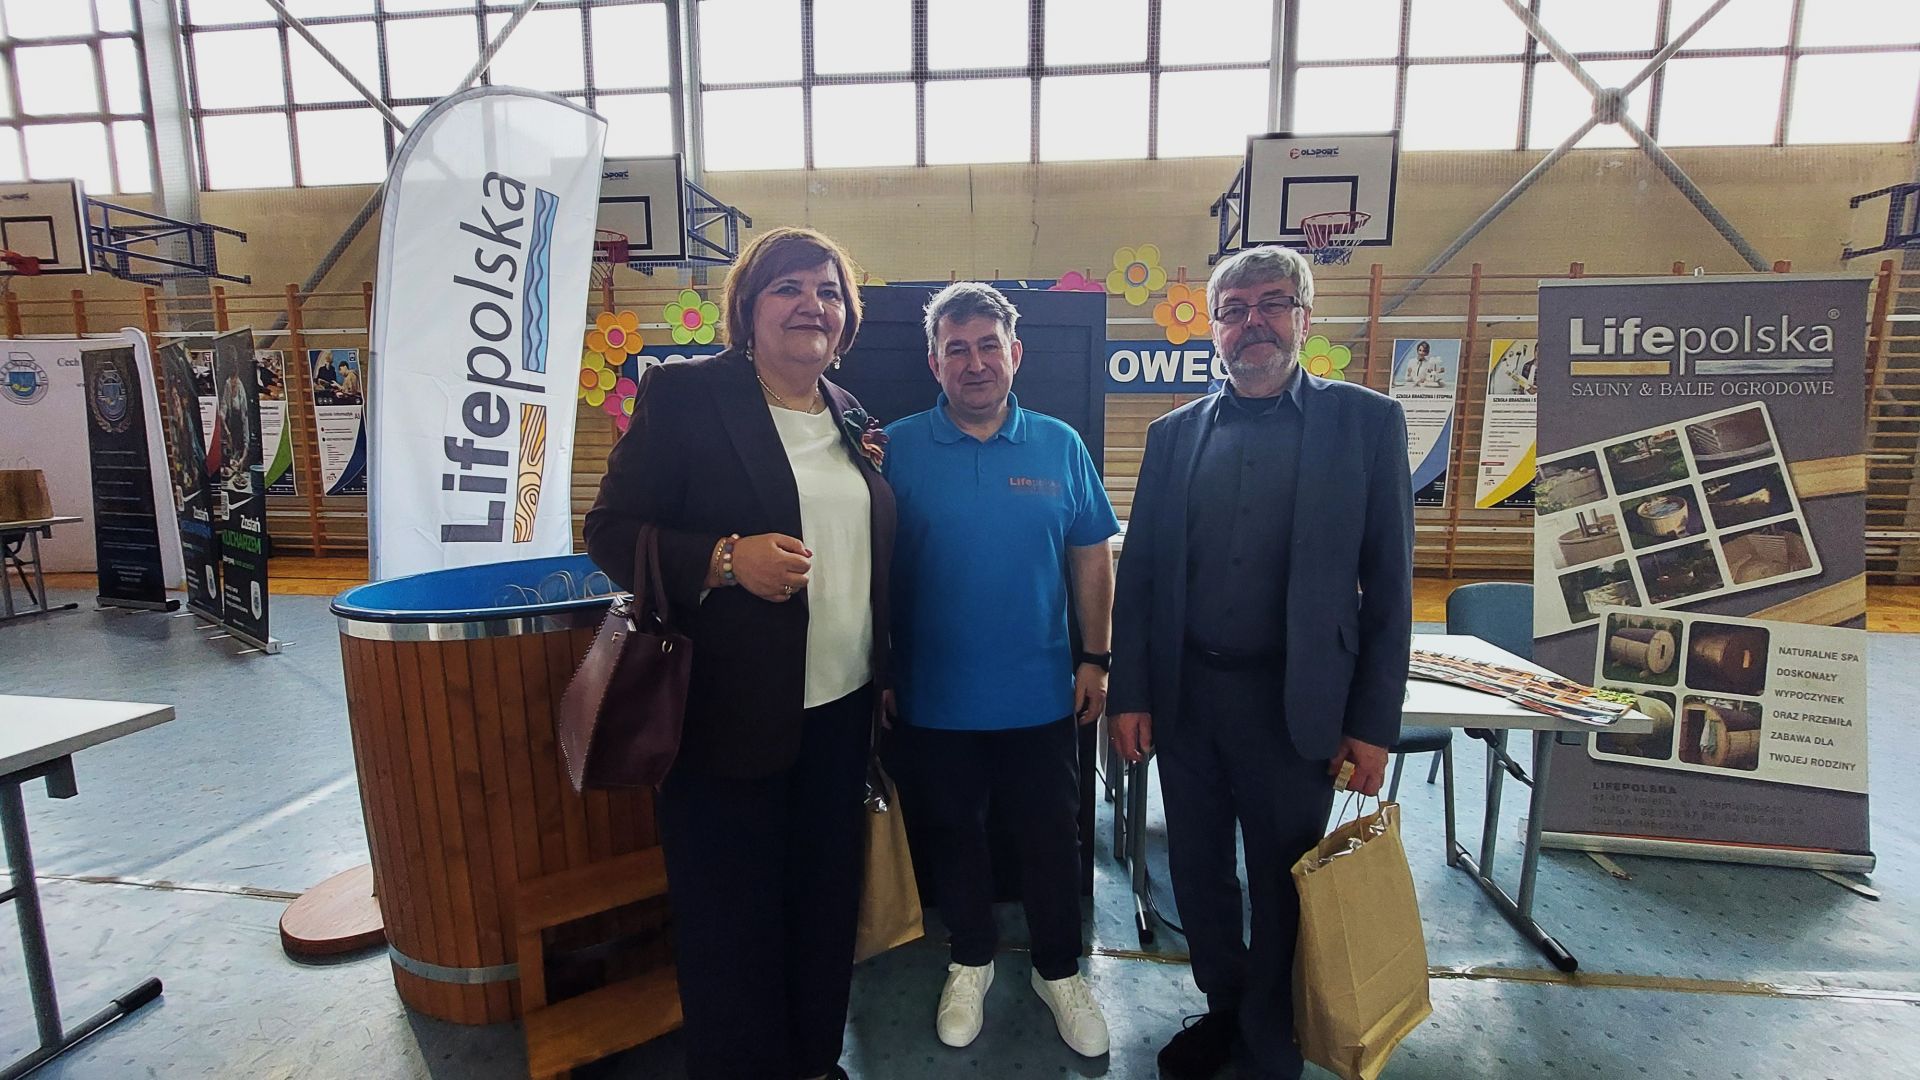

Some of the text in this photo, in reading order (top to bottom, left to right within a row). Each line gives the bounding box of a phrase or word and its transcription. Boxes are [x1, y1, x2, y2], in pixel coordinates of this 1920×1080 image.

[57, 357, 80, 367] Cech
[440, 170, 546, 544] Lifepolska
[1105, 349, 1229, 383] OWE
[1571, 381, 1835, 397] SAUNY & BALIE OGRODOWE
[1778, 646, 1859, 662] NATURALNE SPA
[1776, 667, 1838, 682] DOSKONAŁY
[1774, 689, 1845, 705] WYPOCZYNEK
[1772, 710, 1852, 727] ORAZ PRZEMIŁA
[1770, 731, 1834, 747] ZABAWA DLA
[1768, 752, 1856, 771] TWOJEJ RODZINY
[1592, 781, 1677, 795] LIFEPOLSKA
